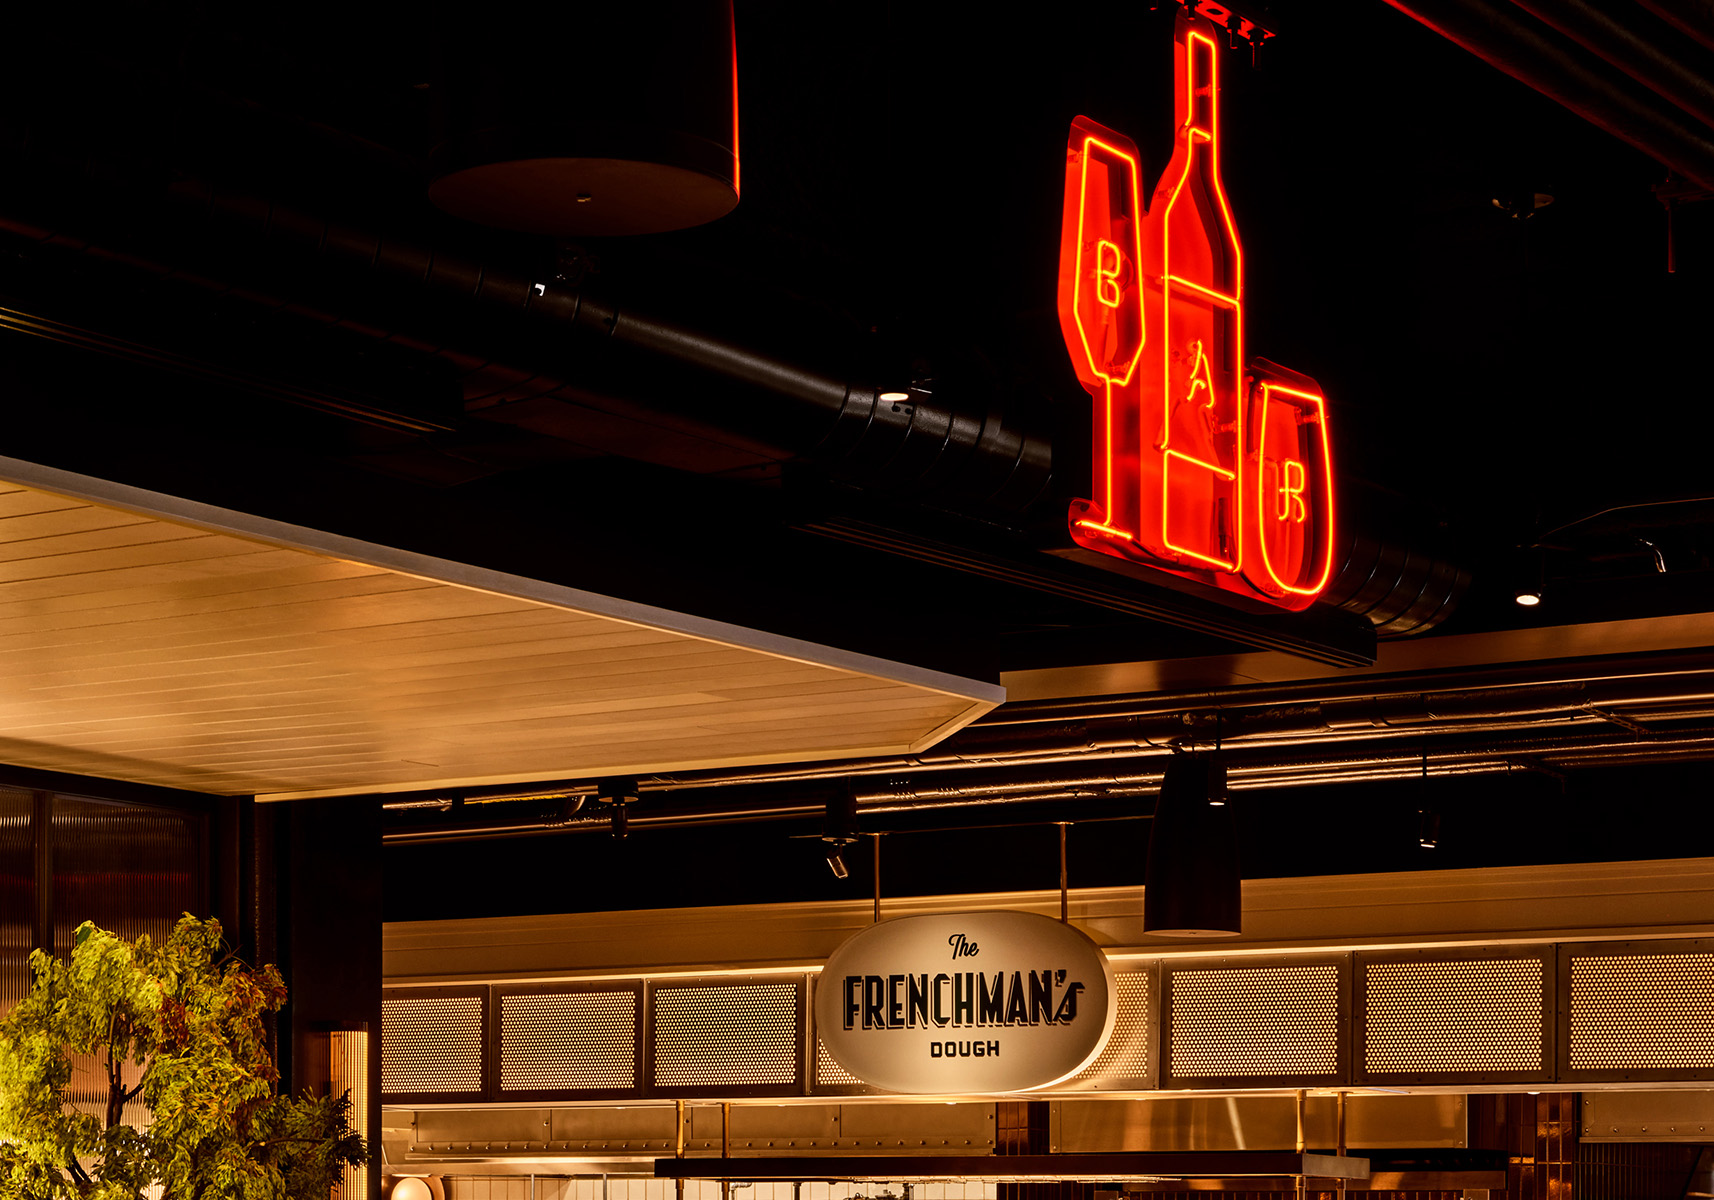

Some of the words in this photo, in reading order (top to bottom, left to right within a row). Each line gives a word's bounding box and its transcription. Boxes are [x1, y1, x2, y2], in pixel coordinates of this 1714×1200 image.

[1097, 239, 1306, 523] BAR
[948, 933, 979, 960] The
[930, 1040, 1000, 1058] DOUGH
